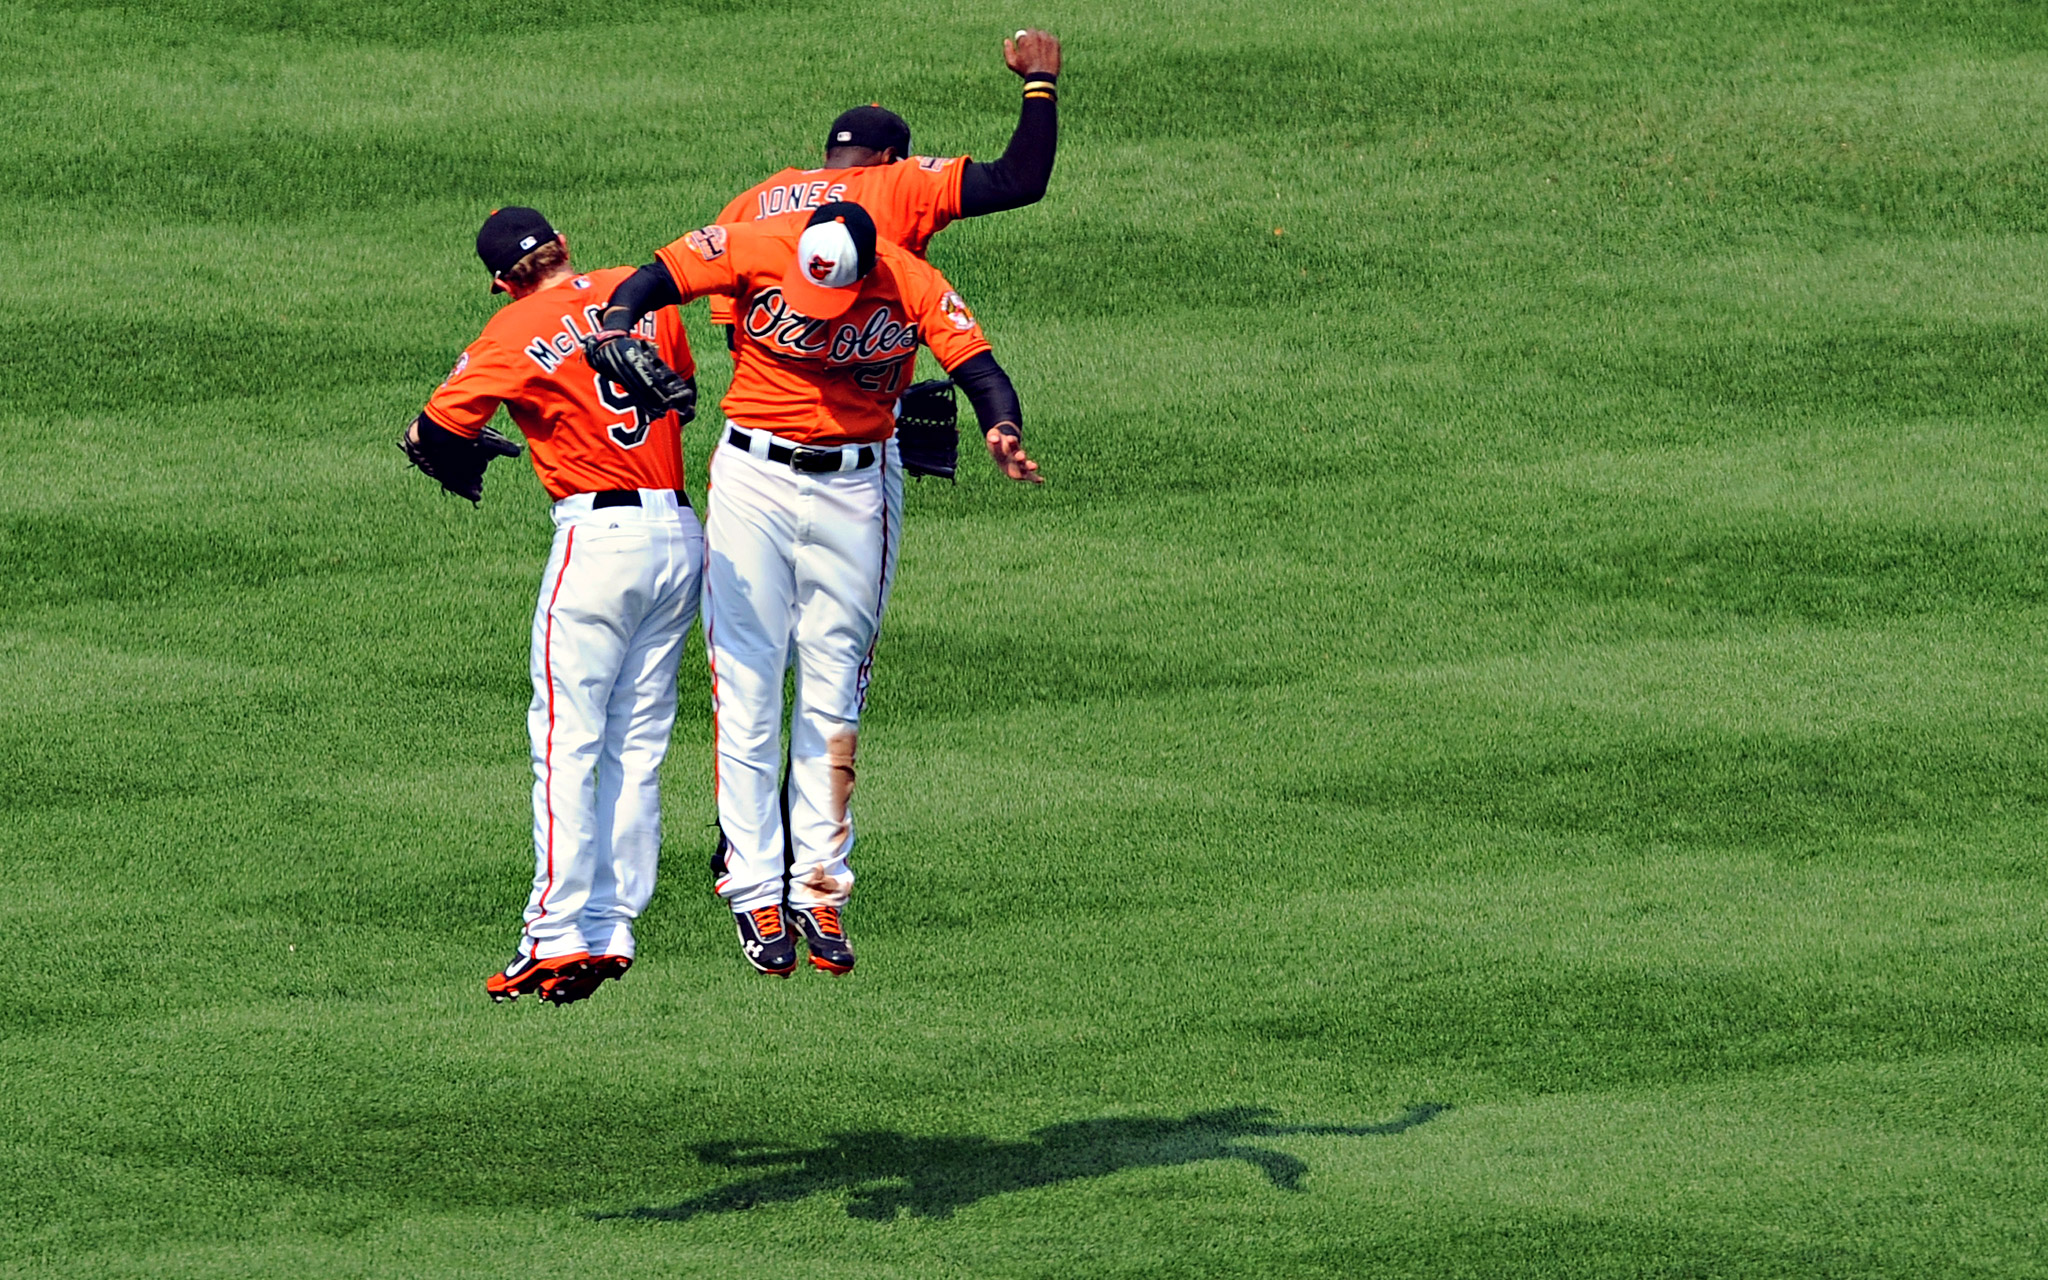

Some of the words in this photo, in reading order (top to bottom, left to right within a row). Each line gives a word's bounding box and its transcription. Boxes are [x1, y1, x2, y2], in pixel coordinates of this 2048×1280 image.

[754, 181, 848, 221] JONES
[523, 301, 658, 374] McLOH
[593, 373, 651, 450] 9
